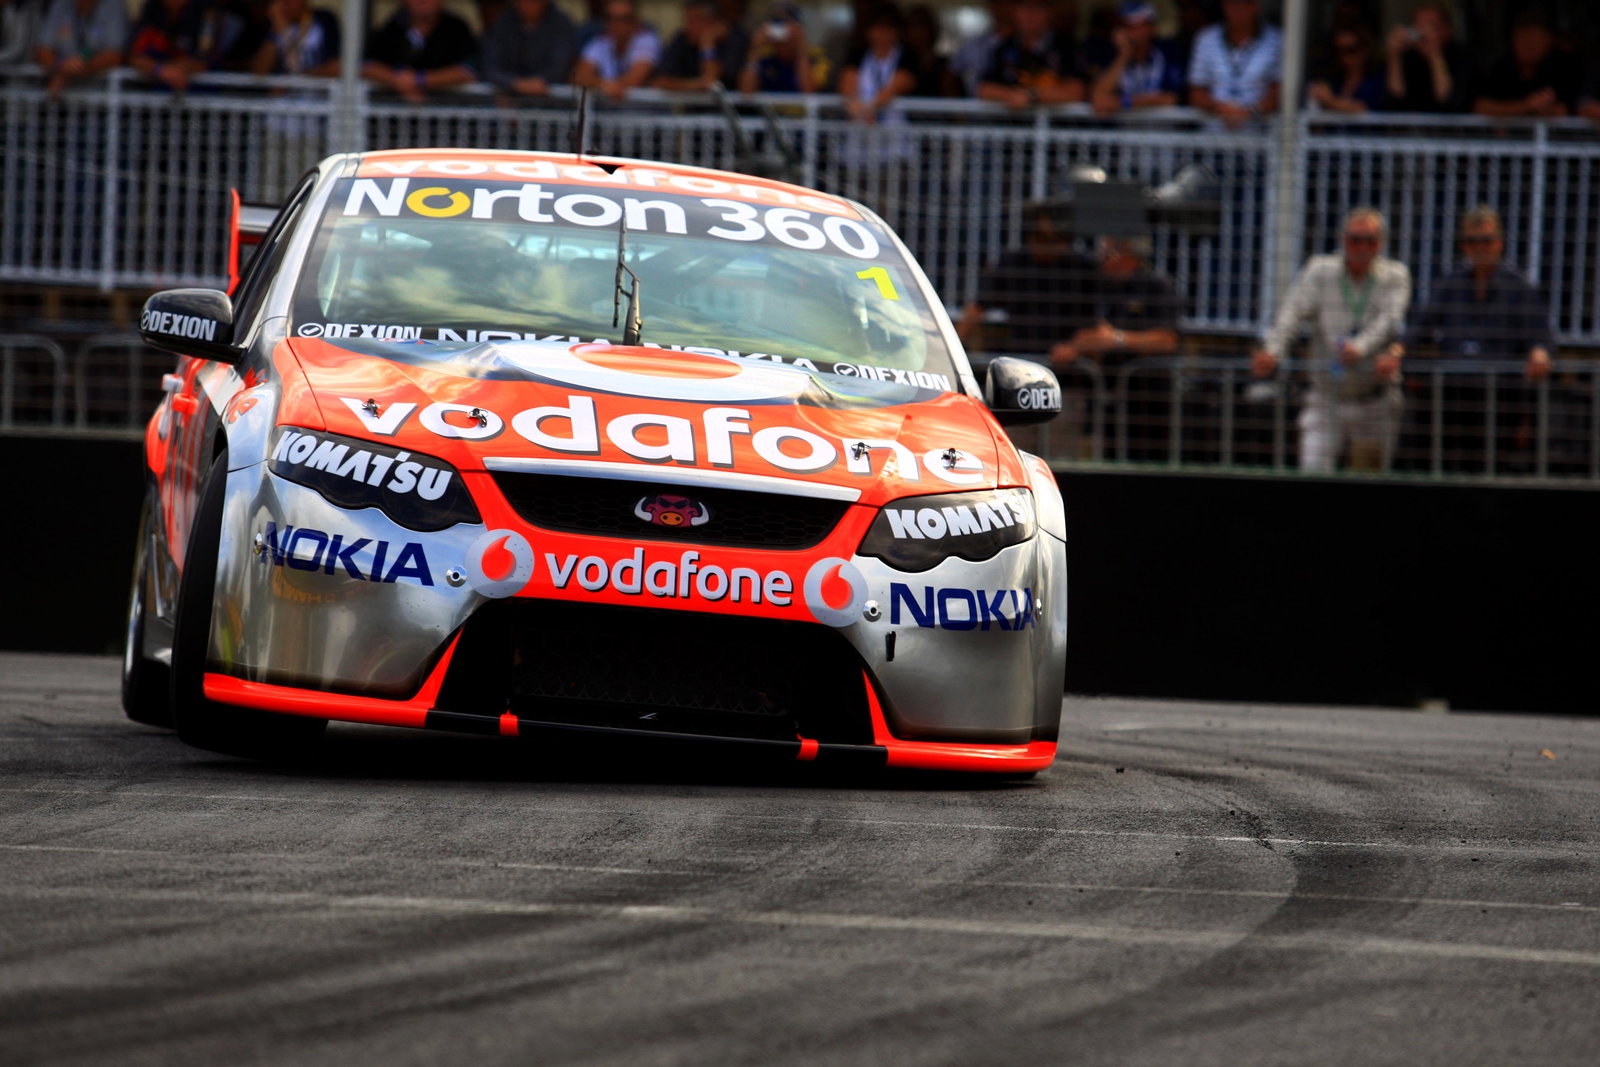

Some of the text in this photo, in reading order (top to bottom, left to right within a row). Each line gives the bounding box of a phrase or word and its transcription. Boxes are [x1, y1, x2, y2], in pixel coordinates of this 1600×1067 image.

[342, 176, 880, 260] Norton 360
[856, 266, 899, 301] 1
[149, 311, 217, 342] DEXION
[324, 323, 422, 340] DEXION
[858, 364, 953, 391] DEXION
[339, 394, 986, 486] vodafone
[260, 522, 435, 587] NOKIA
[544, 546, 793, 608] vodafone
[890, 582, 1036, 632] NOKIA
